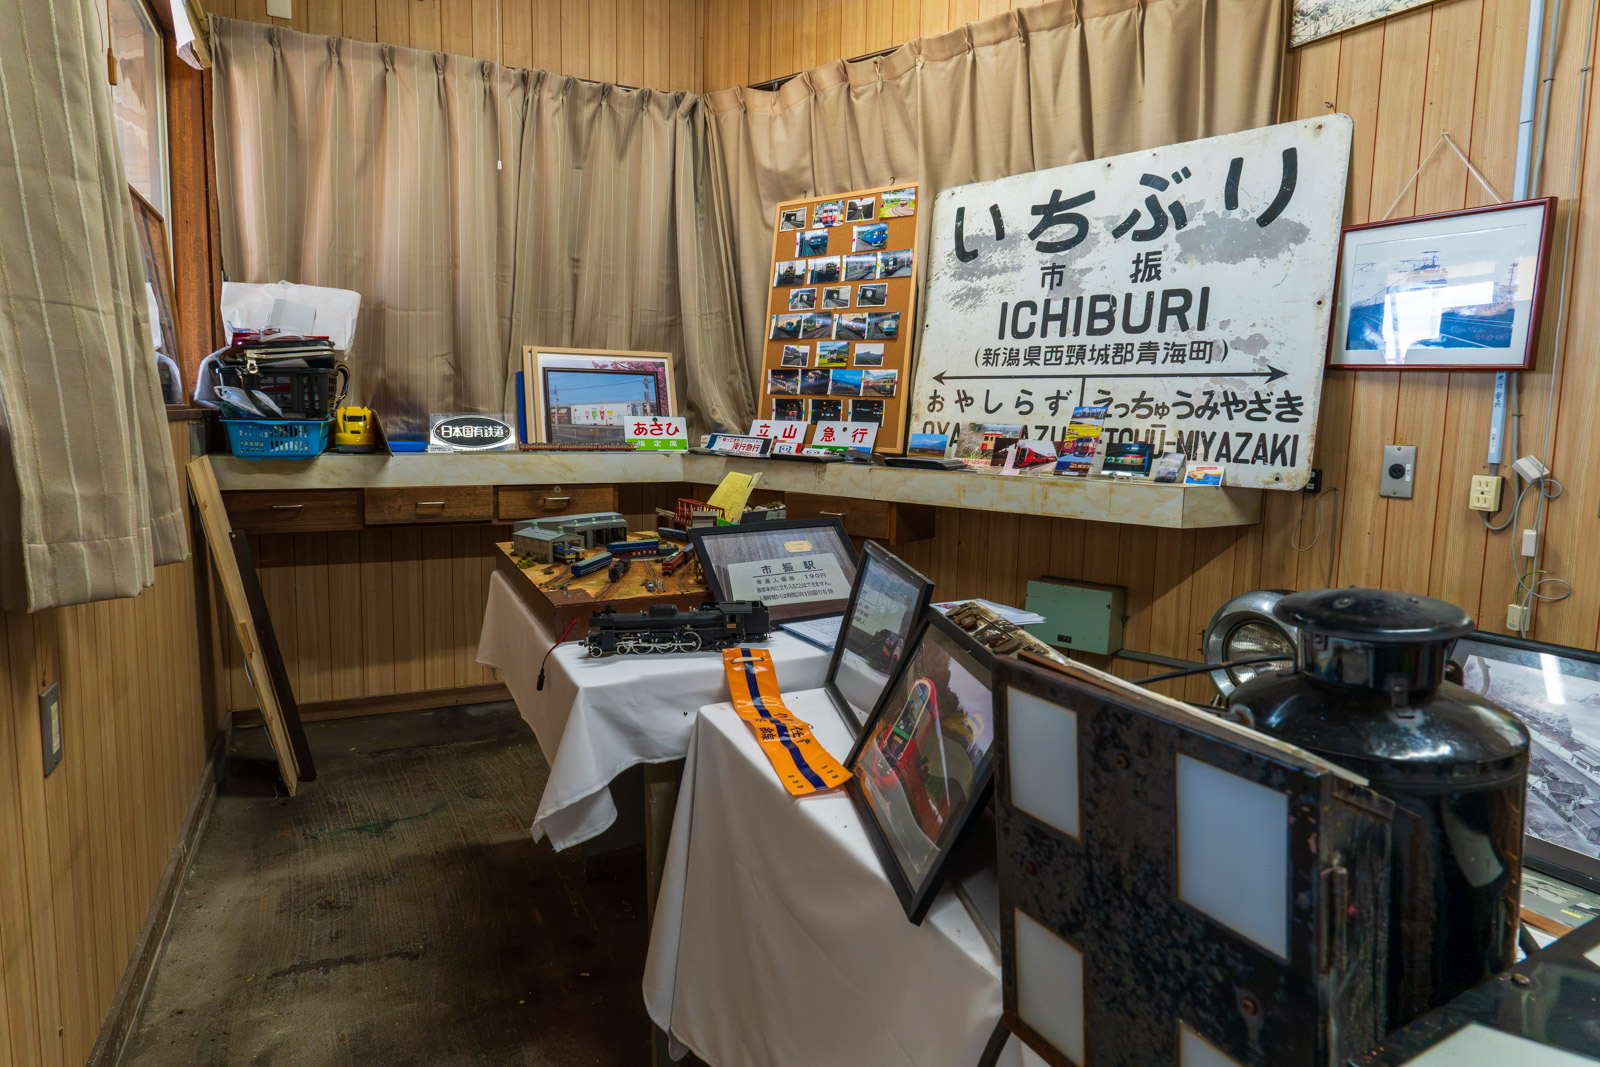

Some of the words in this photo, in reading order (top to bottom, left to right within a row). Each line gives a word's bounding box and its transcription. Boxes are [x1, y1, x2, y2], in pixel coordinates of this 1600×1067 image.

[954, 147, 1298, 263] いちぶり
[1040, 251, 1163, 290] 市振
[998, 286, 1210, 340] ICHIBURI
[927, 388, 1073, 417] おやしらず
[1093, 388, 1304, 423] えっちゅうみやざき
[441, 425, 505, 438] 日本国有鉄道
[633, 422, 680, 436] あさひ
[756, 424, 798, 439] 立山
[820, 426, 868, 443] 急行
[761, 560, 816, 575] 市振駅
